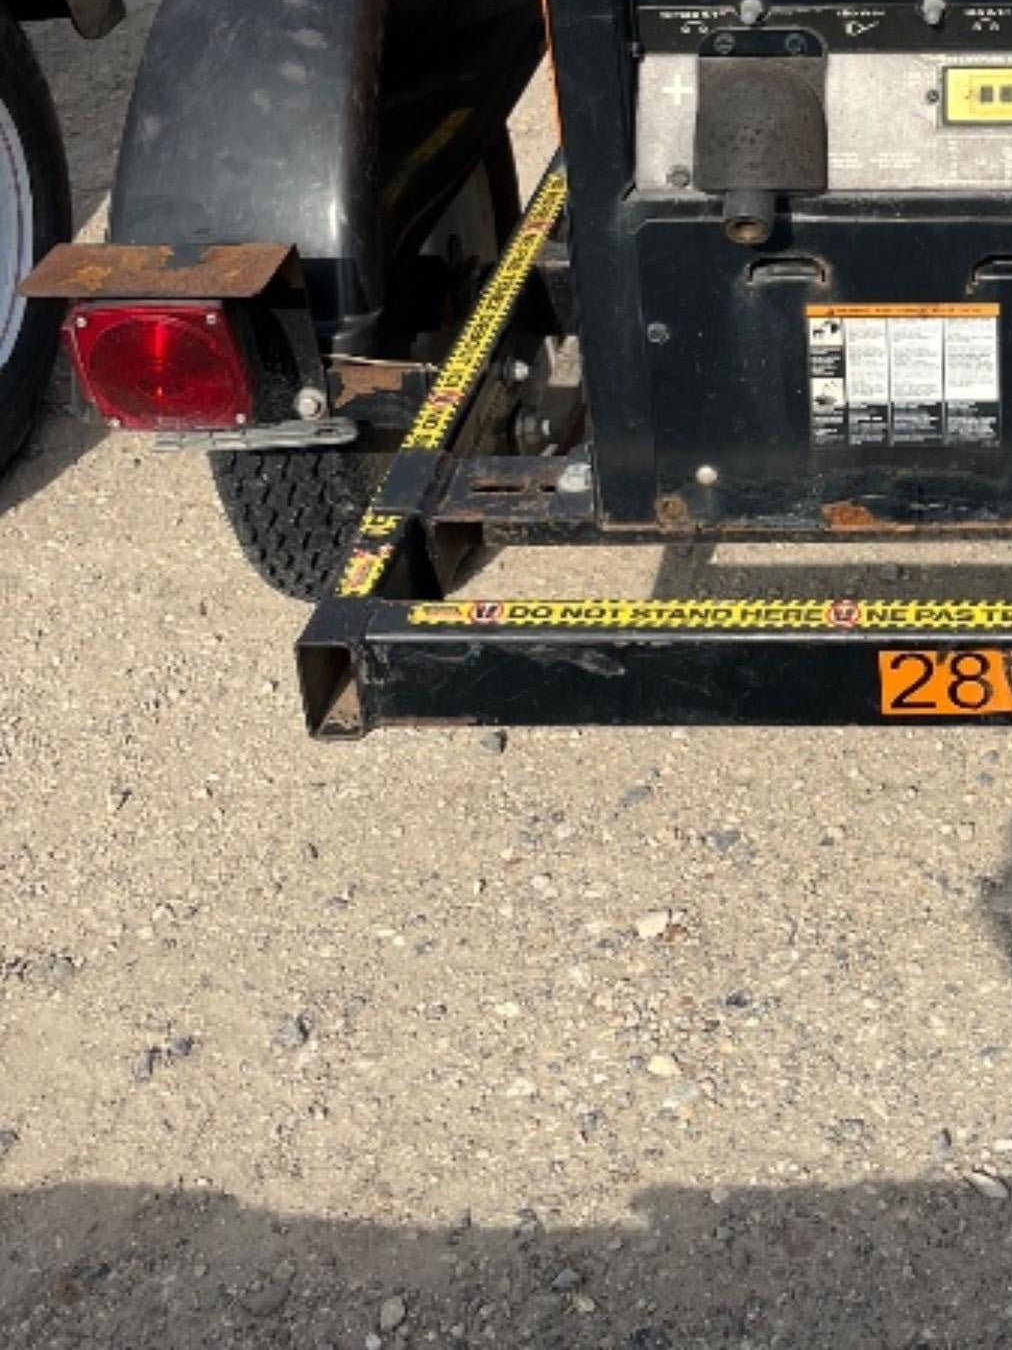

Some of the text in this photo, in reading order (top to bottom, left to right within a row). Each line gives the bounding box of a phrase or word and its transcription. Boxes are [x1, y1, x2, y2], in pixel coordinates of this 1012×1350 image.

[508, 605, 552, 619] DO
[560, 606, 621, 619] NOT
[629, 607, 733, 620] STAND
[740, 608, 821, 621] HERE
[866, 608, 907, 622] NE
[914, 609, 977, 622] PAS
